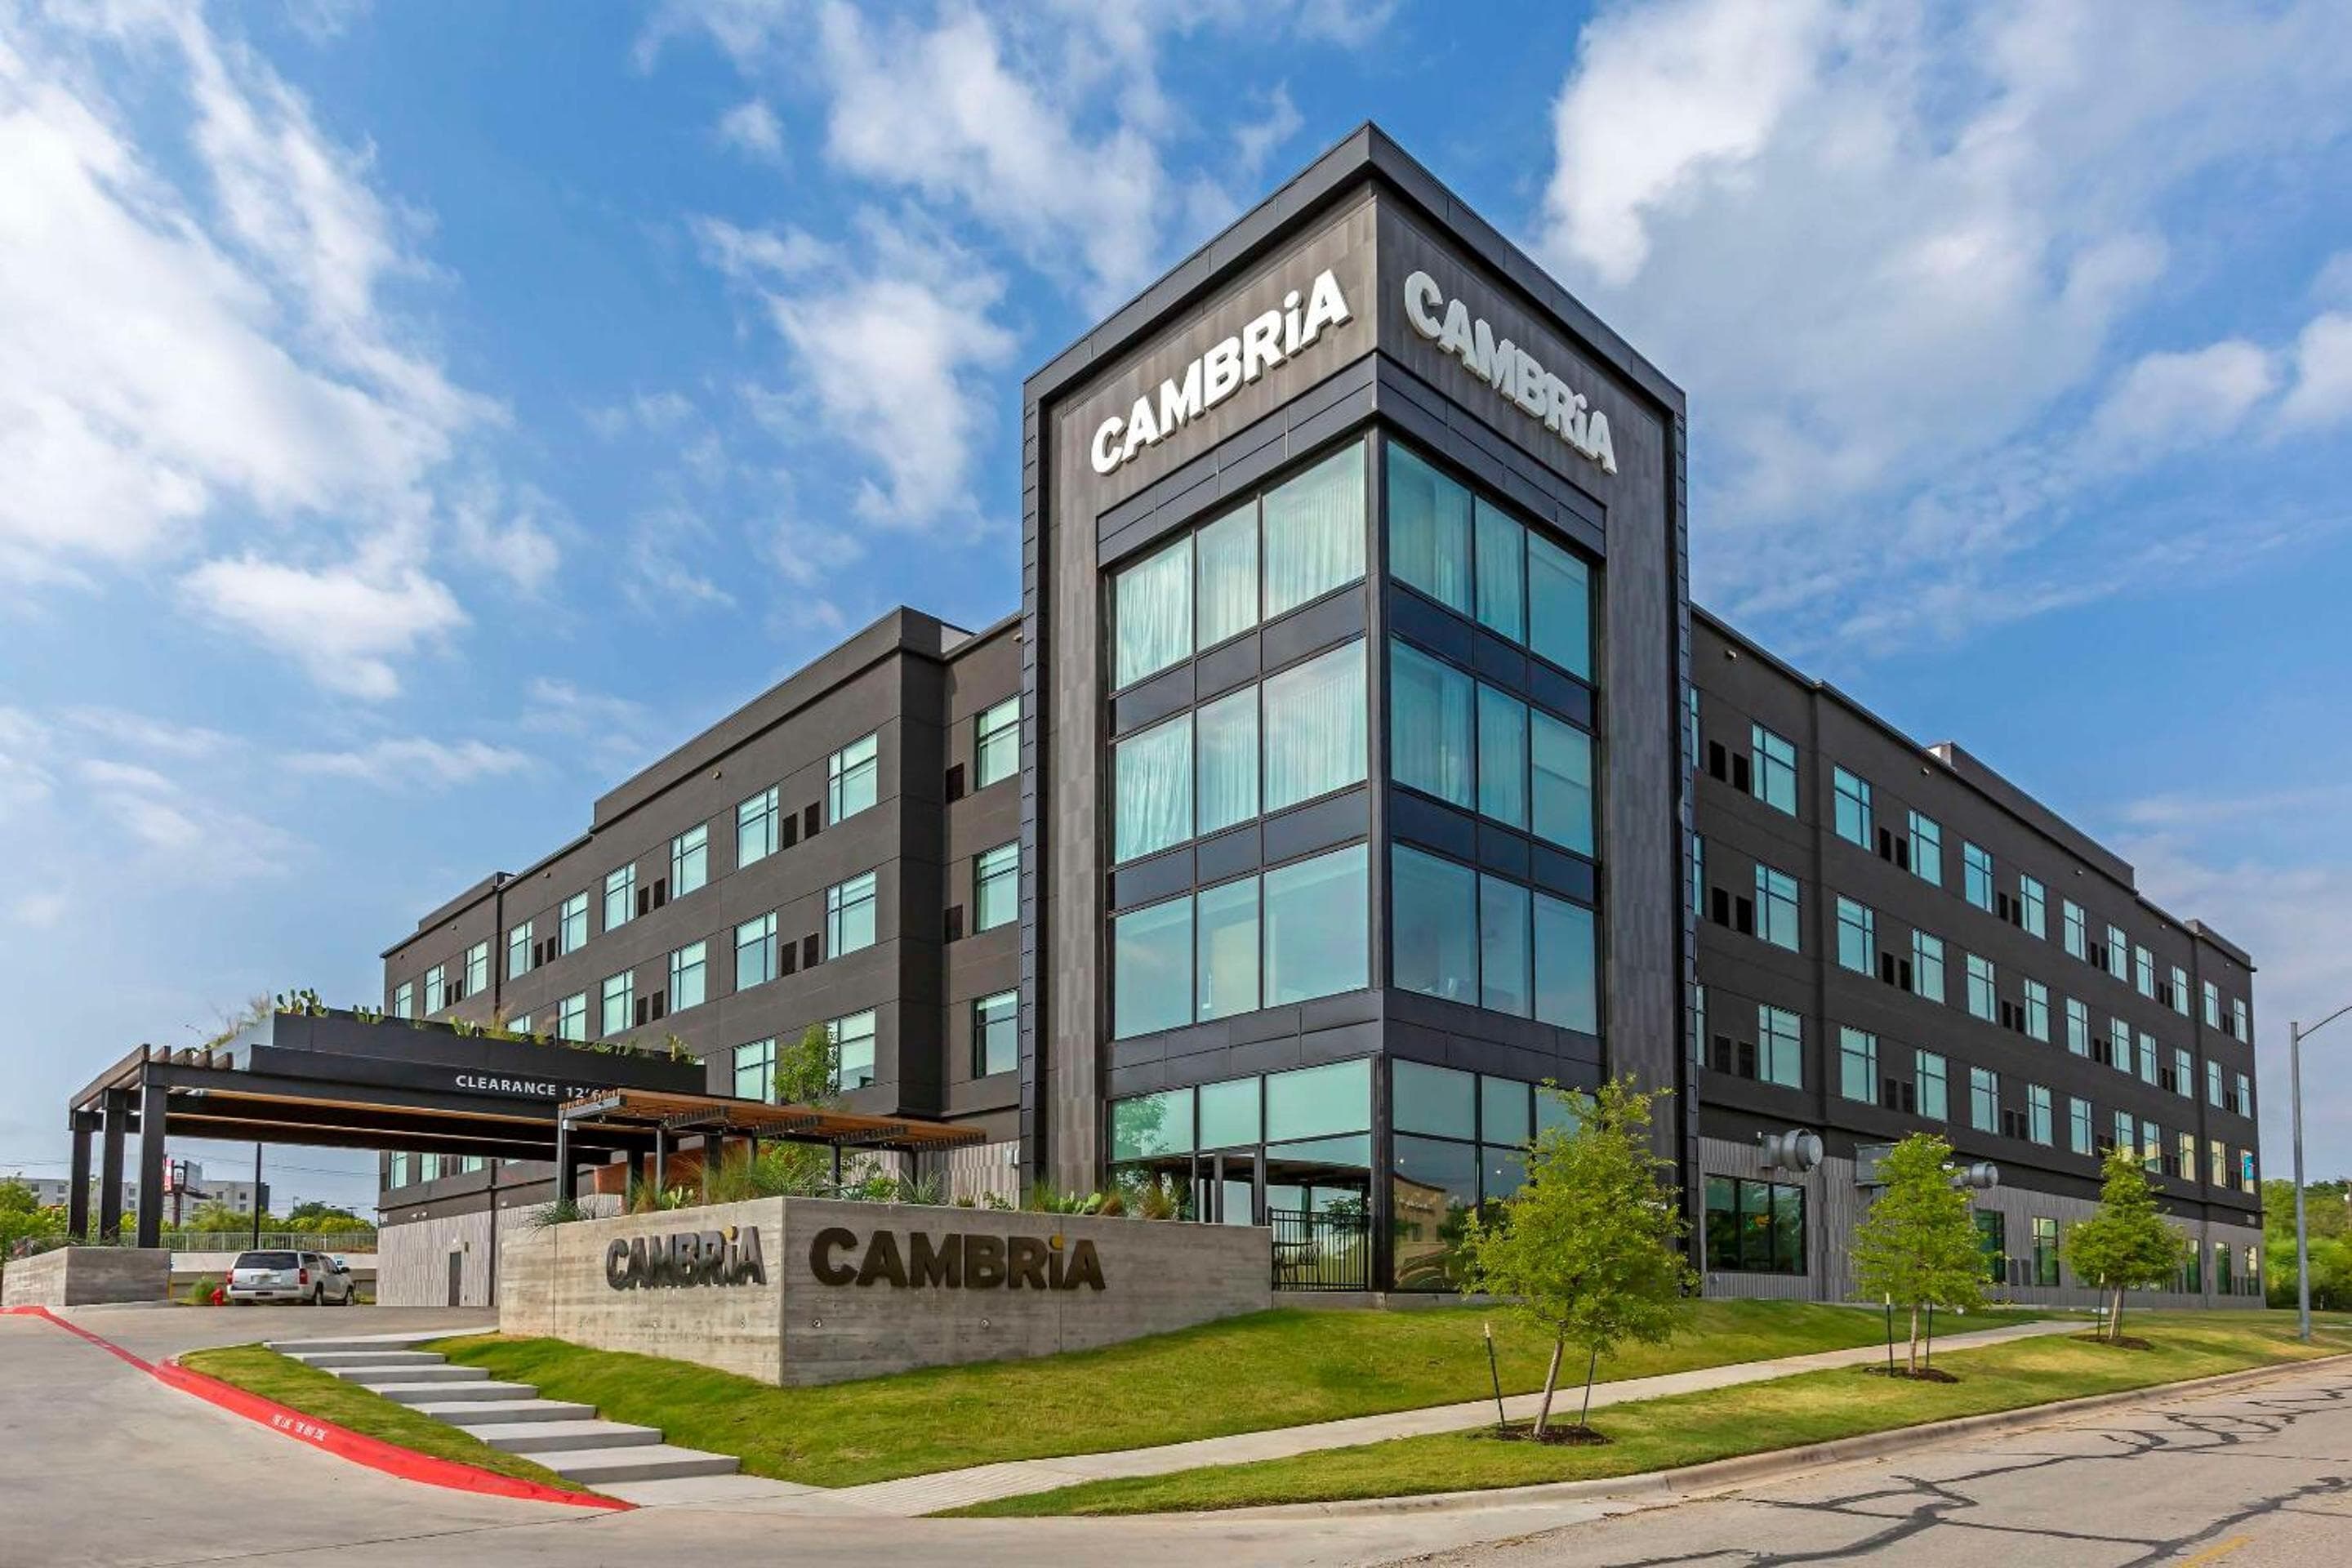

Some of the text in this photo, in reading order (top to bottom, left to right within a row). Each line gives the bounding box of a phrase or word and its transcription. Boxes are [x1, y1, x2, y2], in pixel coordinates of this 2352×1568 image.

[1090, 269, 1353, 475] CAMBRiA
[1404, 270, 1618, 475] CAMBRiA
[456, 1074, 556, 1096] CLEARANCE
[607, 1226, 767, 1290] CAMBRiA
[809, 1227, 1106, 1290] CAMBRiA
